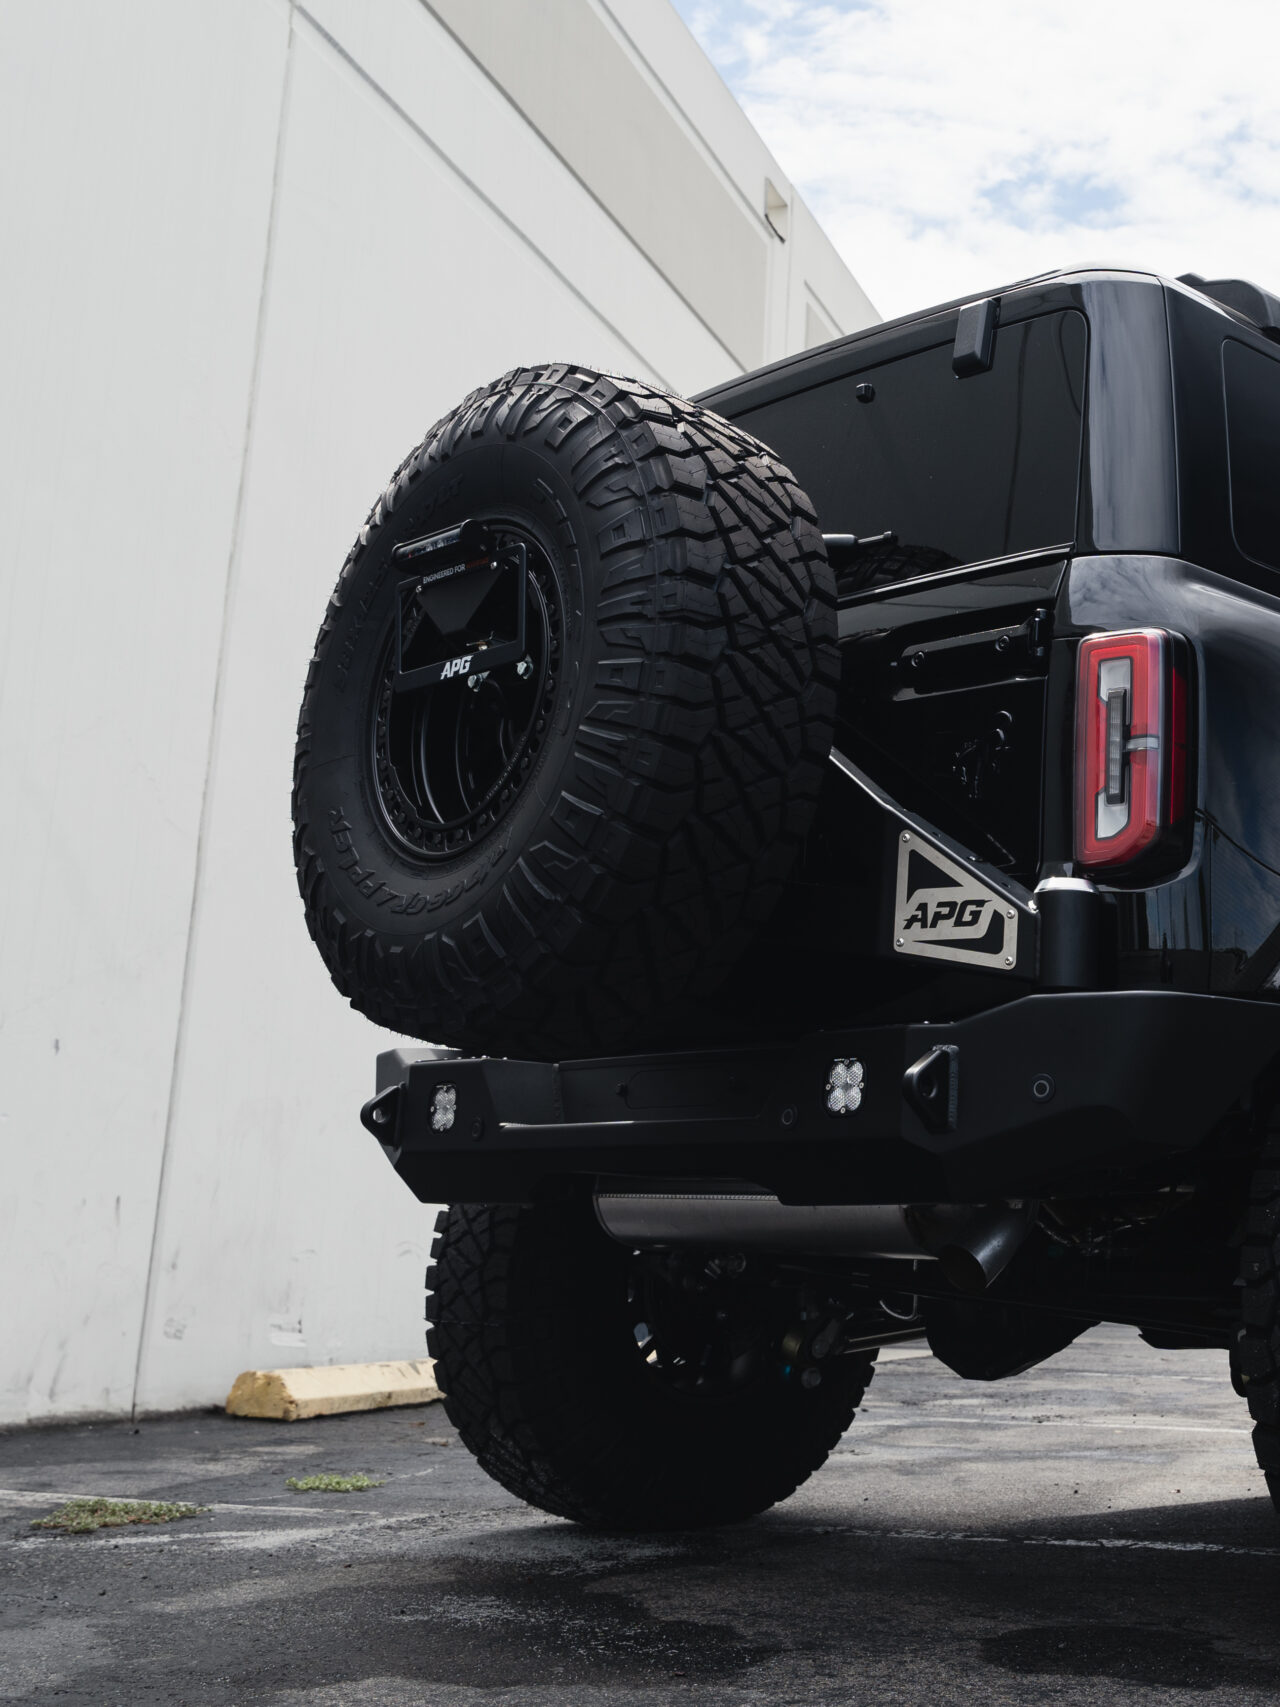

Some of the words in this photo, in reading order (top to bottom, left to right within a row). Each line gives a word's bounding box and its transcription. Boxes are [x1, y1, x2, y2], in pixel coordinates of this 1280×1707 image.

[422, 567, 453, 584] ENGINEERED
[454, 563, 466, 574] FOR
[440, 655, 474, 680] APG
[902, 899, 993, 930] APG
